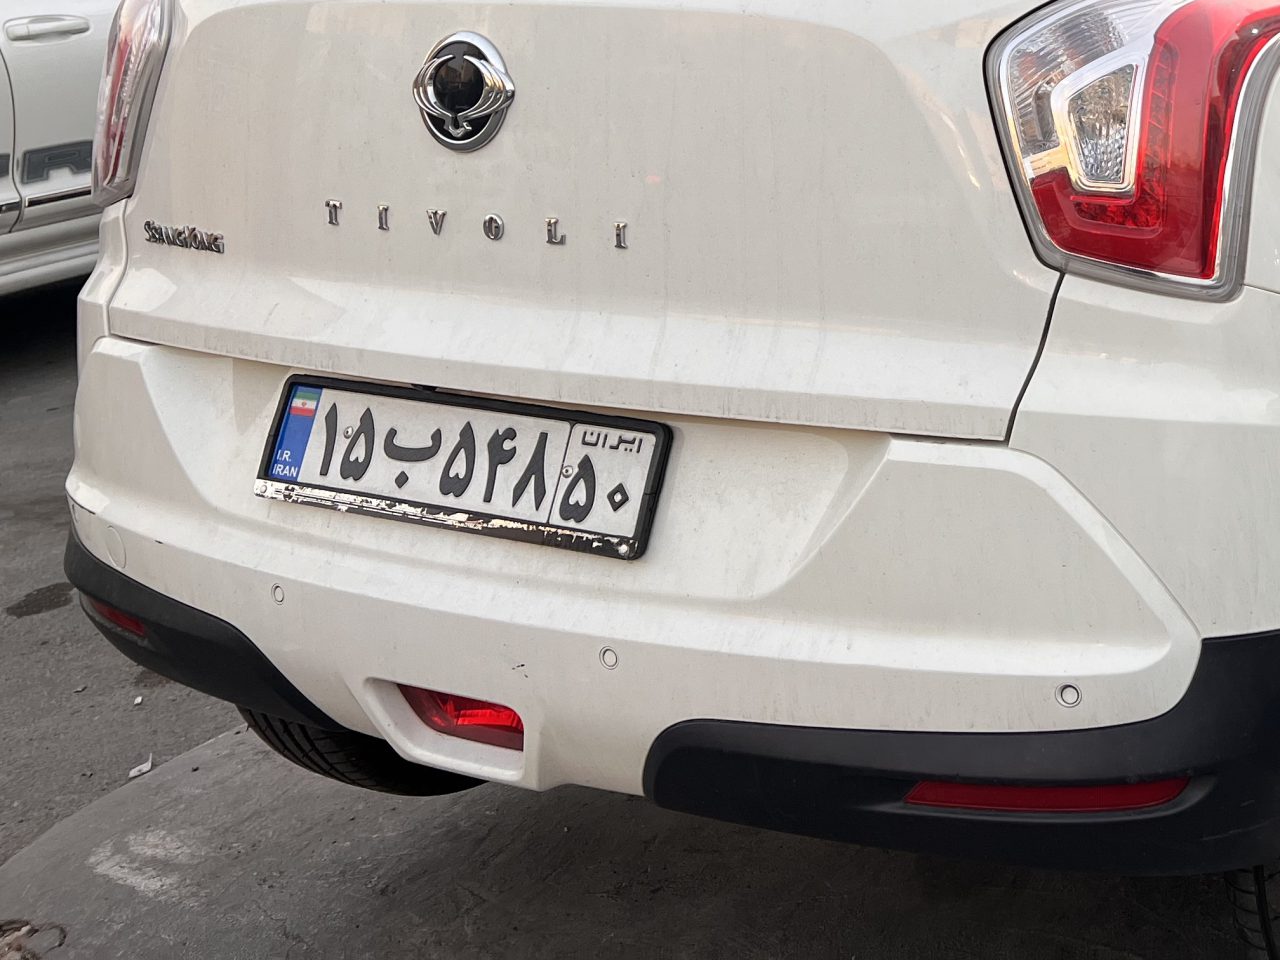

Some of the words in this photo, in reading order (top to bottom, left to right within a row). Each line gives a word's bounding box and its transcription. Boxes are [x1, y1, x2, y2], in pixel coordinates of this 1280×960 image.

[324, 199, 629, 250] TIVOLI
[580, 429, 643, 454] ایران
[276, 449, 292, 462] I.R.
[272, 463, 298, 478] IRAN
[558, 454, 630, 524] ۵۰
